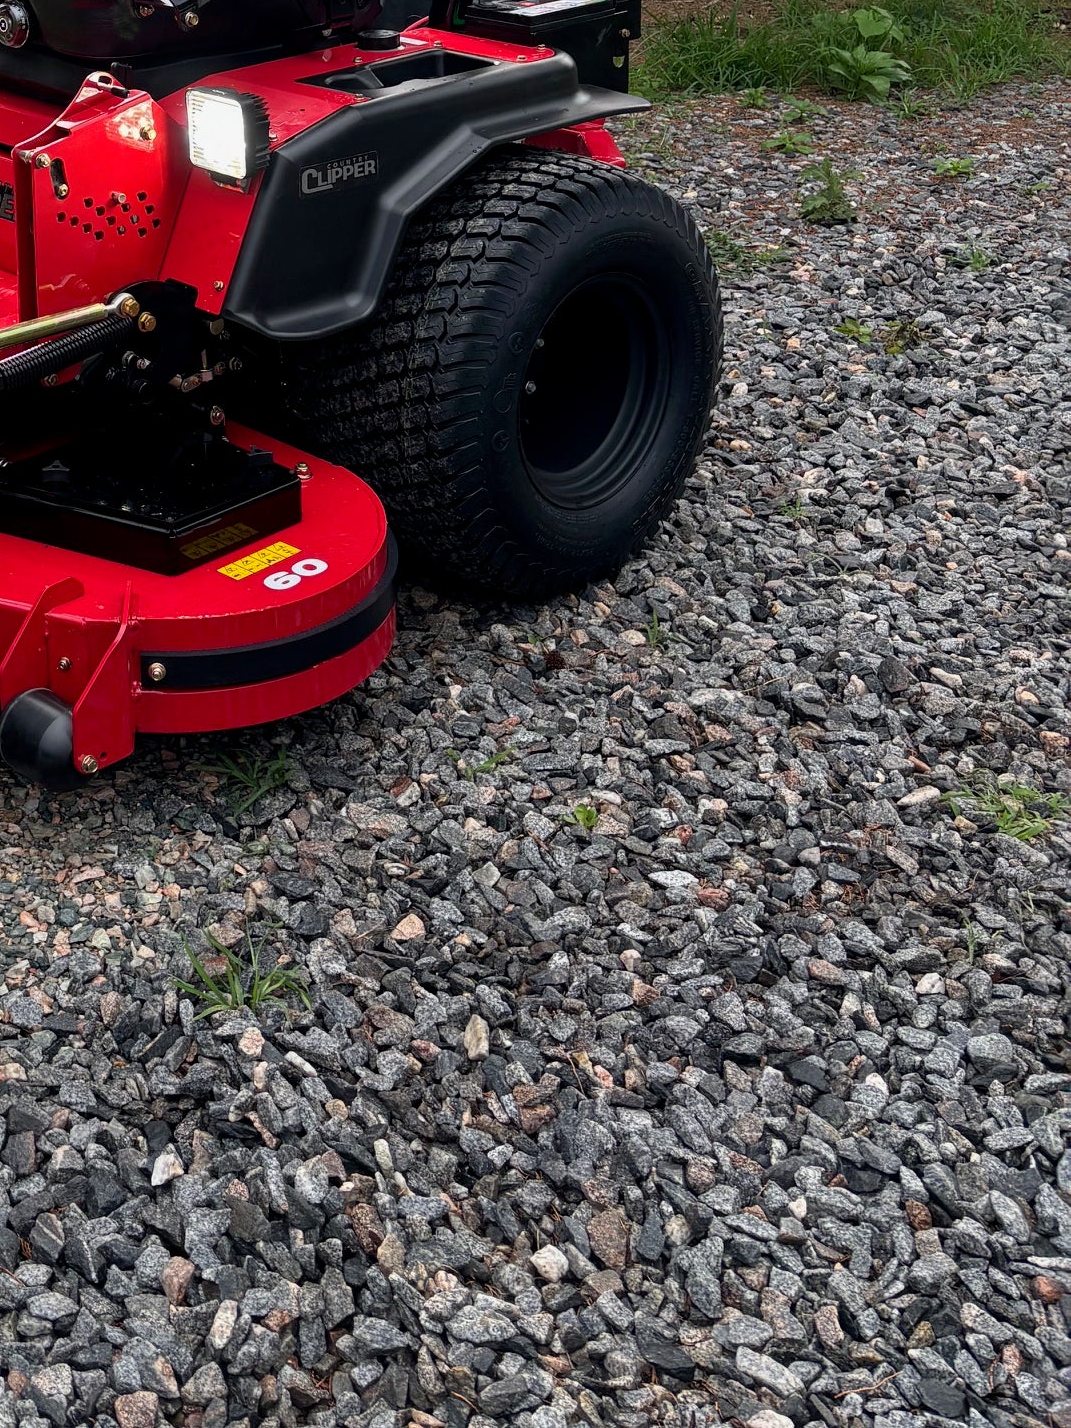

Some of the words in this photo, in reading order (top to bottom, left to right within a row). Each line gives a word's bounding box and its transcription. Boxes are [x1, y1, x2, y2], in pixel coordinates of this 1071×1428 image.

[301, 159, 376, 194] CLIPPER
[327, 155, 369, 169] COUNTRY
[263, 557, 329, 590] 60
